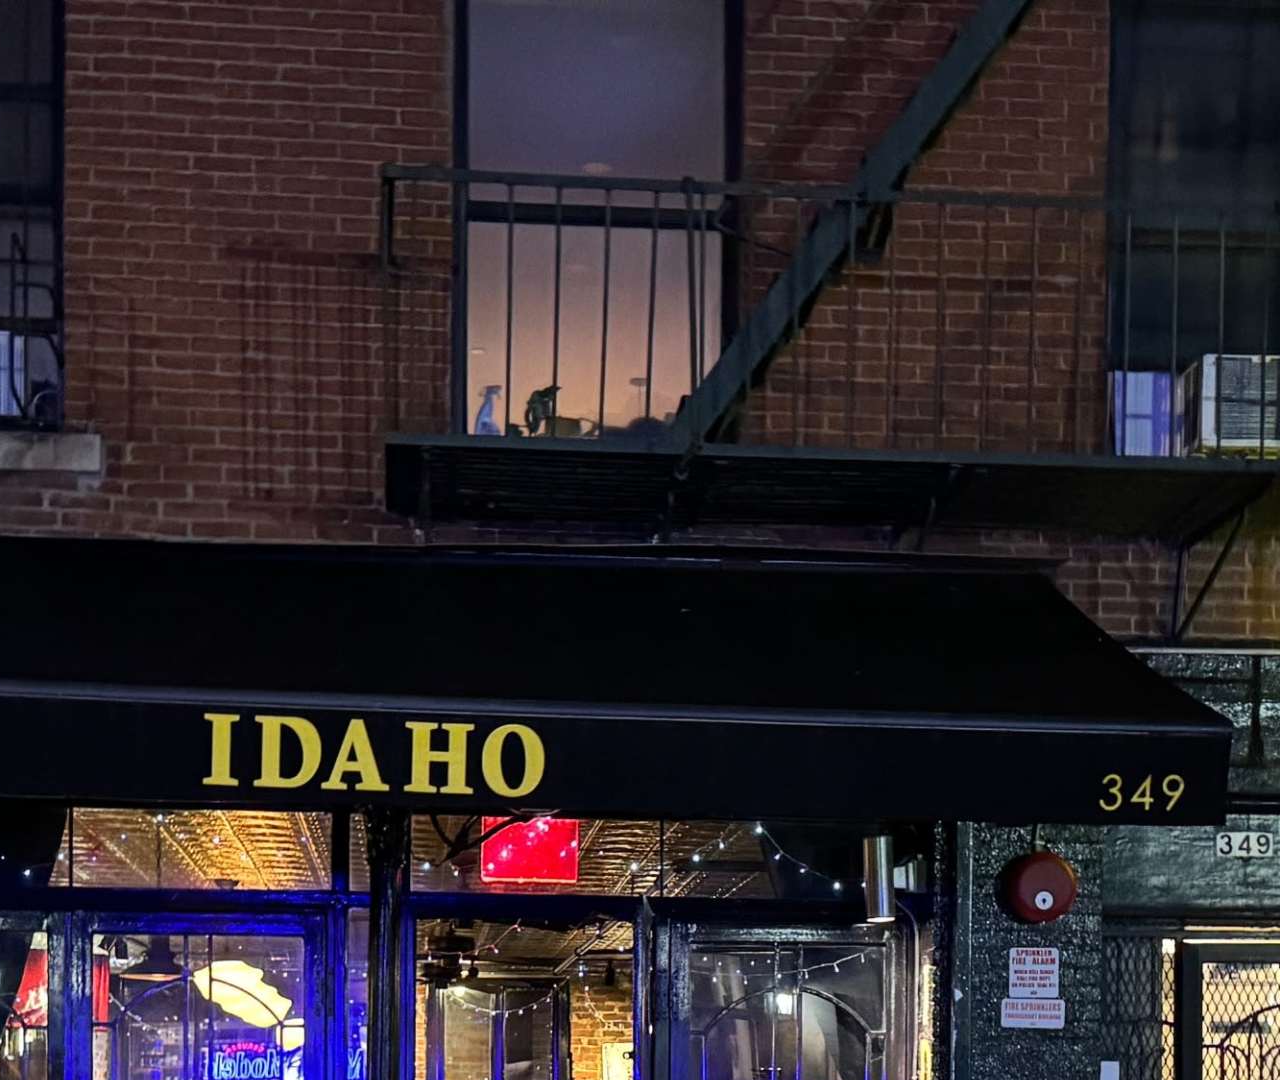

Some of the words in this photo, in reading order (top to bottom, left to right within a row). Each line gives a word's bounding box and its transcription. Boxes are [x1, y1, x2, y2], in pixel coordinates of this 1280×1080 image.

[202, 712, 545, 797] IDAHO
[1099, 774, 1185, 811] 349
[1220, 834, 1271, 855] 349
